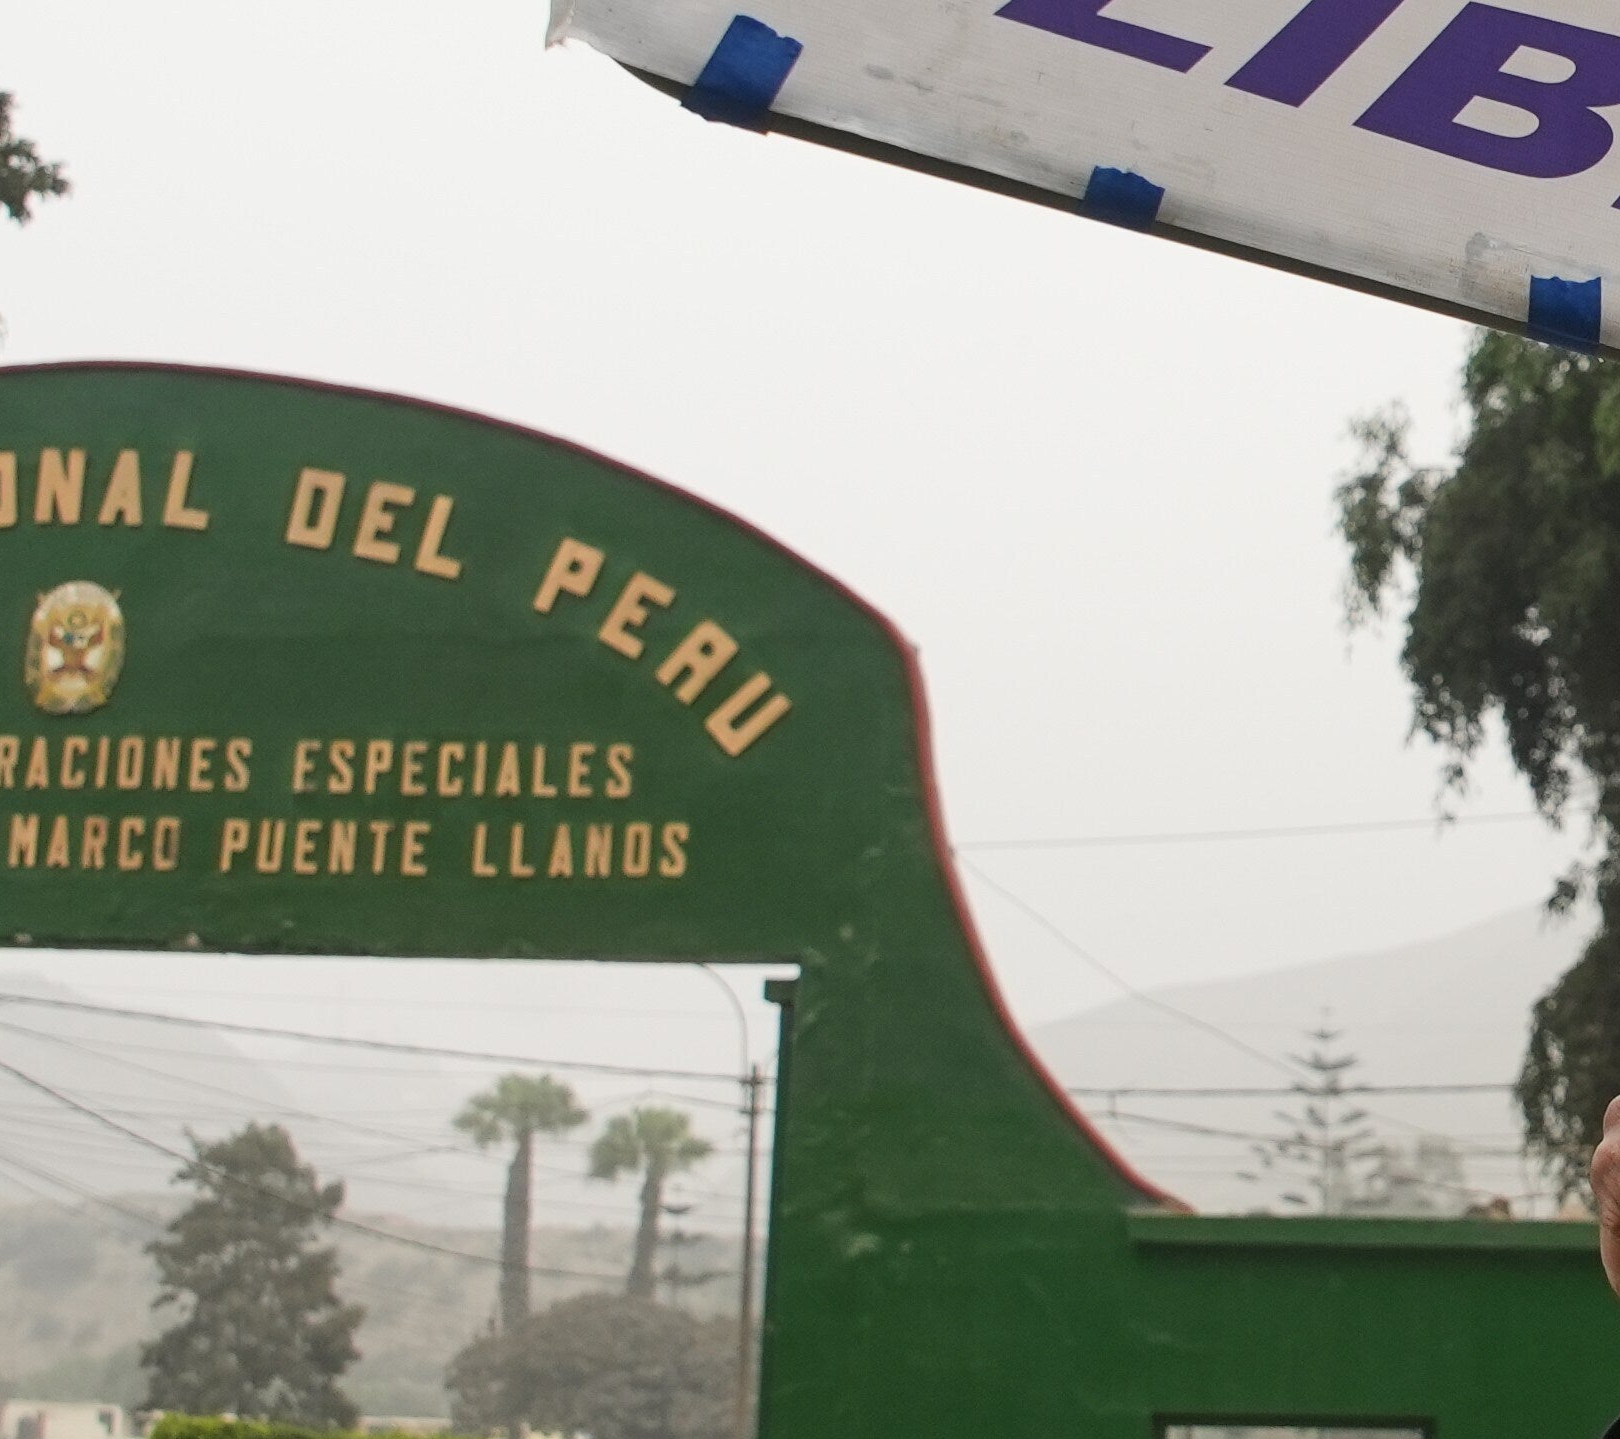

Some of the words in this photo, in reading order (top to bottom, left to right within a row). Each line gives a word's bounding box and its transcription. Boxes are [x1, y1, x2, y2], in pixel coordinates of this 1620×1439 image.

[286, 468, 464, 578] DEL
[533, 537, 790, 757] PERU
[291, 740, 632, 798] ESPECIALES
[7, 815, 179, 871] MARCO
[218, 819, 428, 876] PUENTE
[470, 824, 690, 878] LLANOS
